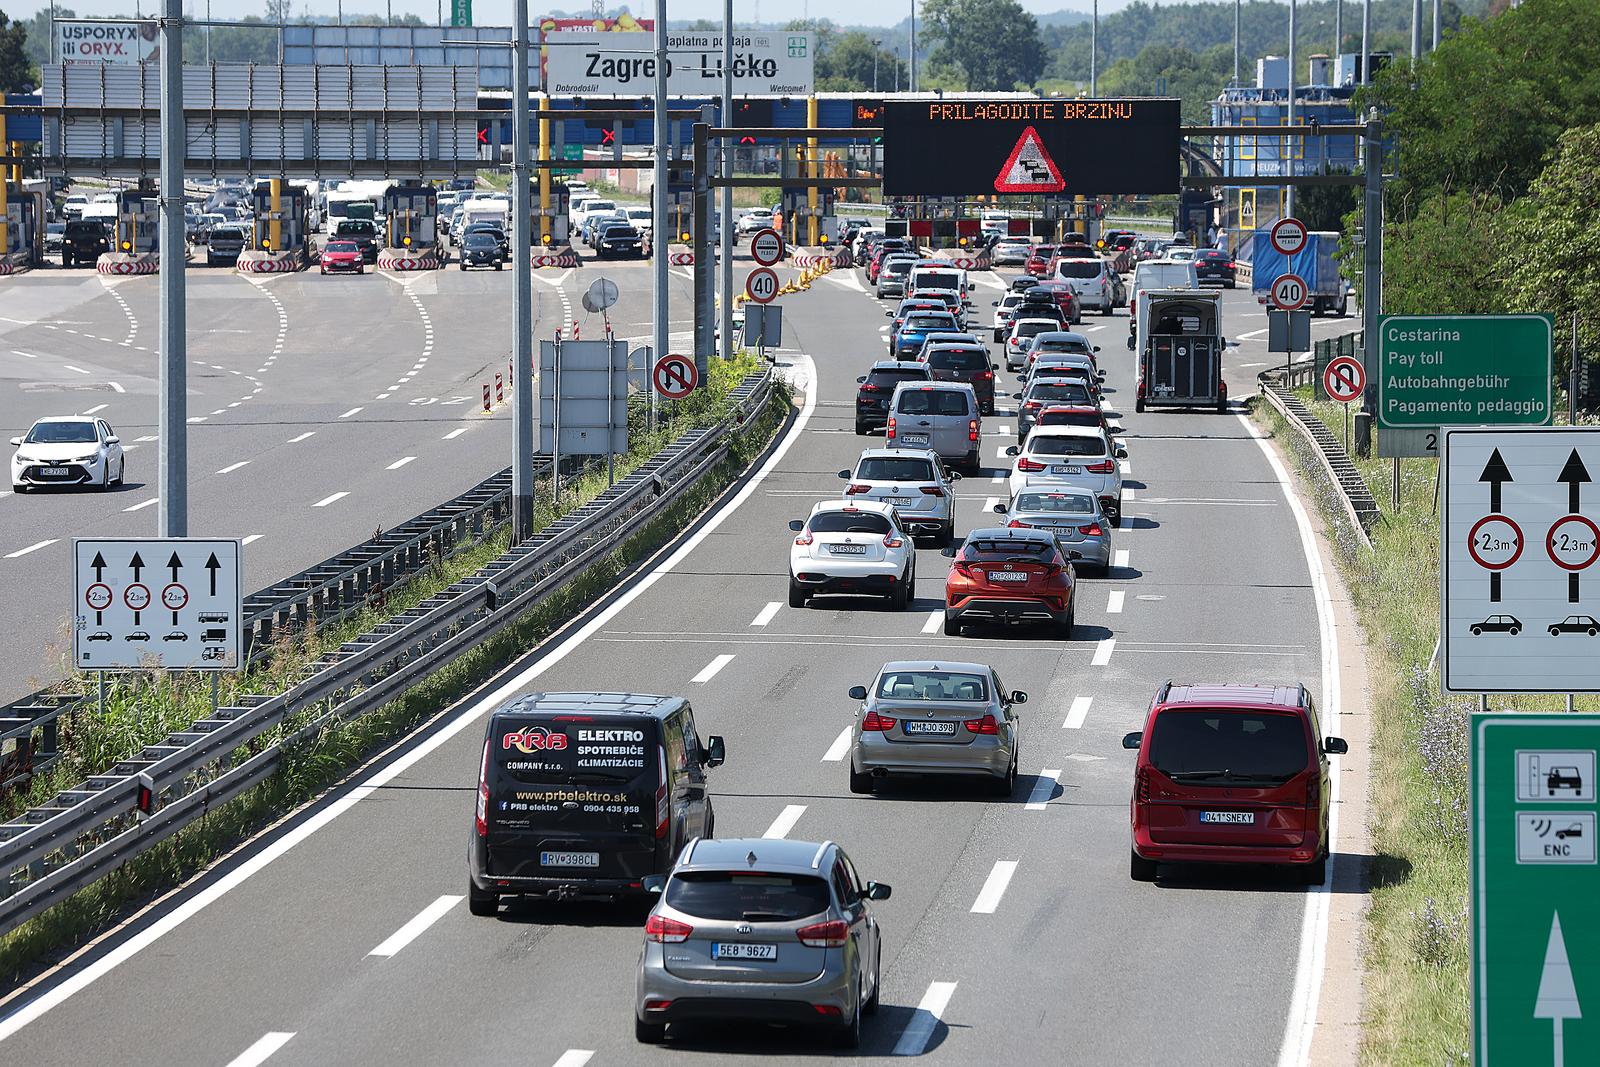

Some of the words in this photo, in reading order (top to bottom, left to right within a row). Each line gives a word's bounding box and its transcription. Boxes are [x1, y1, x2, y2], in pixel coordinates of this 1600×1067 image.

[62, 26, 137, 40] USPORYX
[62, 41, 75, 55] ili
[80, 42, 128, 55] ORYX.
[666, 36, 708, 49] aplatna
[556, 84, 599, 93] Dobrodošli!
[769, 85, 807, 93] Welcome!
[929, 104, 1055, 120] PRILAGODITE
[1063, 103, 1132, 119] BRZINU
[754, 277, 773, 294] 40
[1280, 284, 1300, 301] 40
[1388, 328, 1461, 342] Cestarina
[1388, 351, 1416, 368] Pay
[1420, 351, 1444, 365] toll
[1387, 375, 1510, 392] Autobahngebühr
[1388, 399, 1472, 415] Pagamento
[1477, 398, 1545, 415] pedaggio
[1425, 433, 1438, 451] 2
[502, 732, 568, 750] PRB
[578, 730, 644, 742] ELEKTRO
[577, 744, 644, 755] SPOTREBIČE
[507, 761, 544, 770] COMPANY
[516, 790, 627, 803] www.prbelektro.sk
[510, 803, 528, 811] PRB
[583, 805, 604, 813] 0904
[606, 805, 622, 813] 435
[1544, 844, 1570, 856] ENC
[548, 854, 561, 865] RV
[566, 854, 597, 866] 398CL
[720, 944, 739, 956] 5E8
[746, 945, 772, 957] 9627
